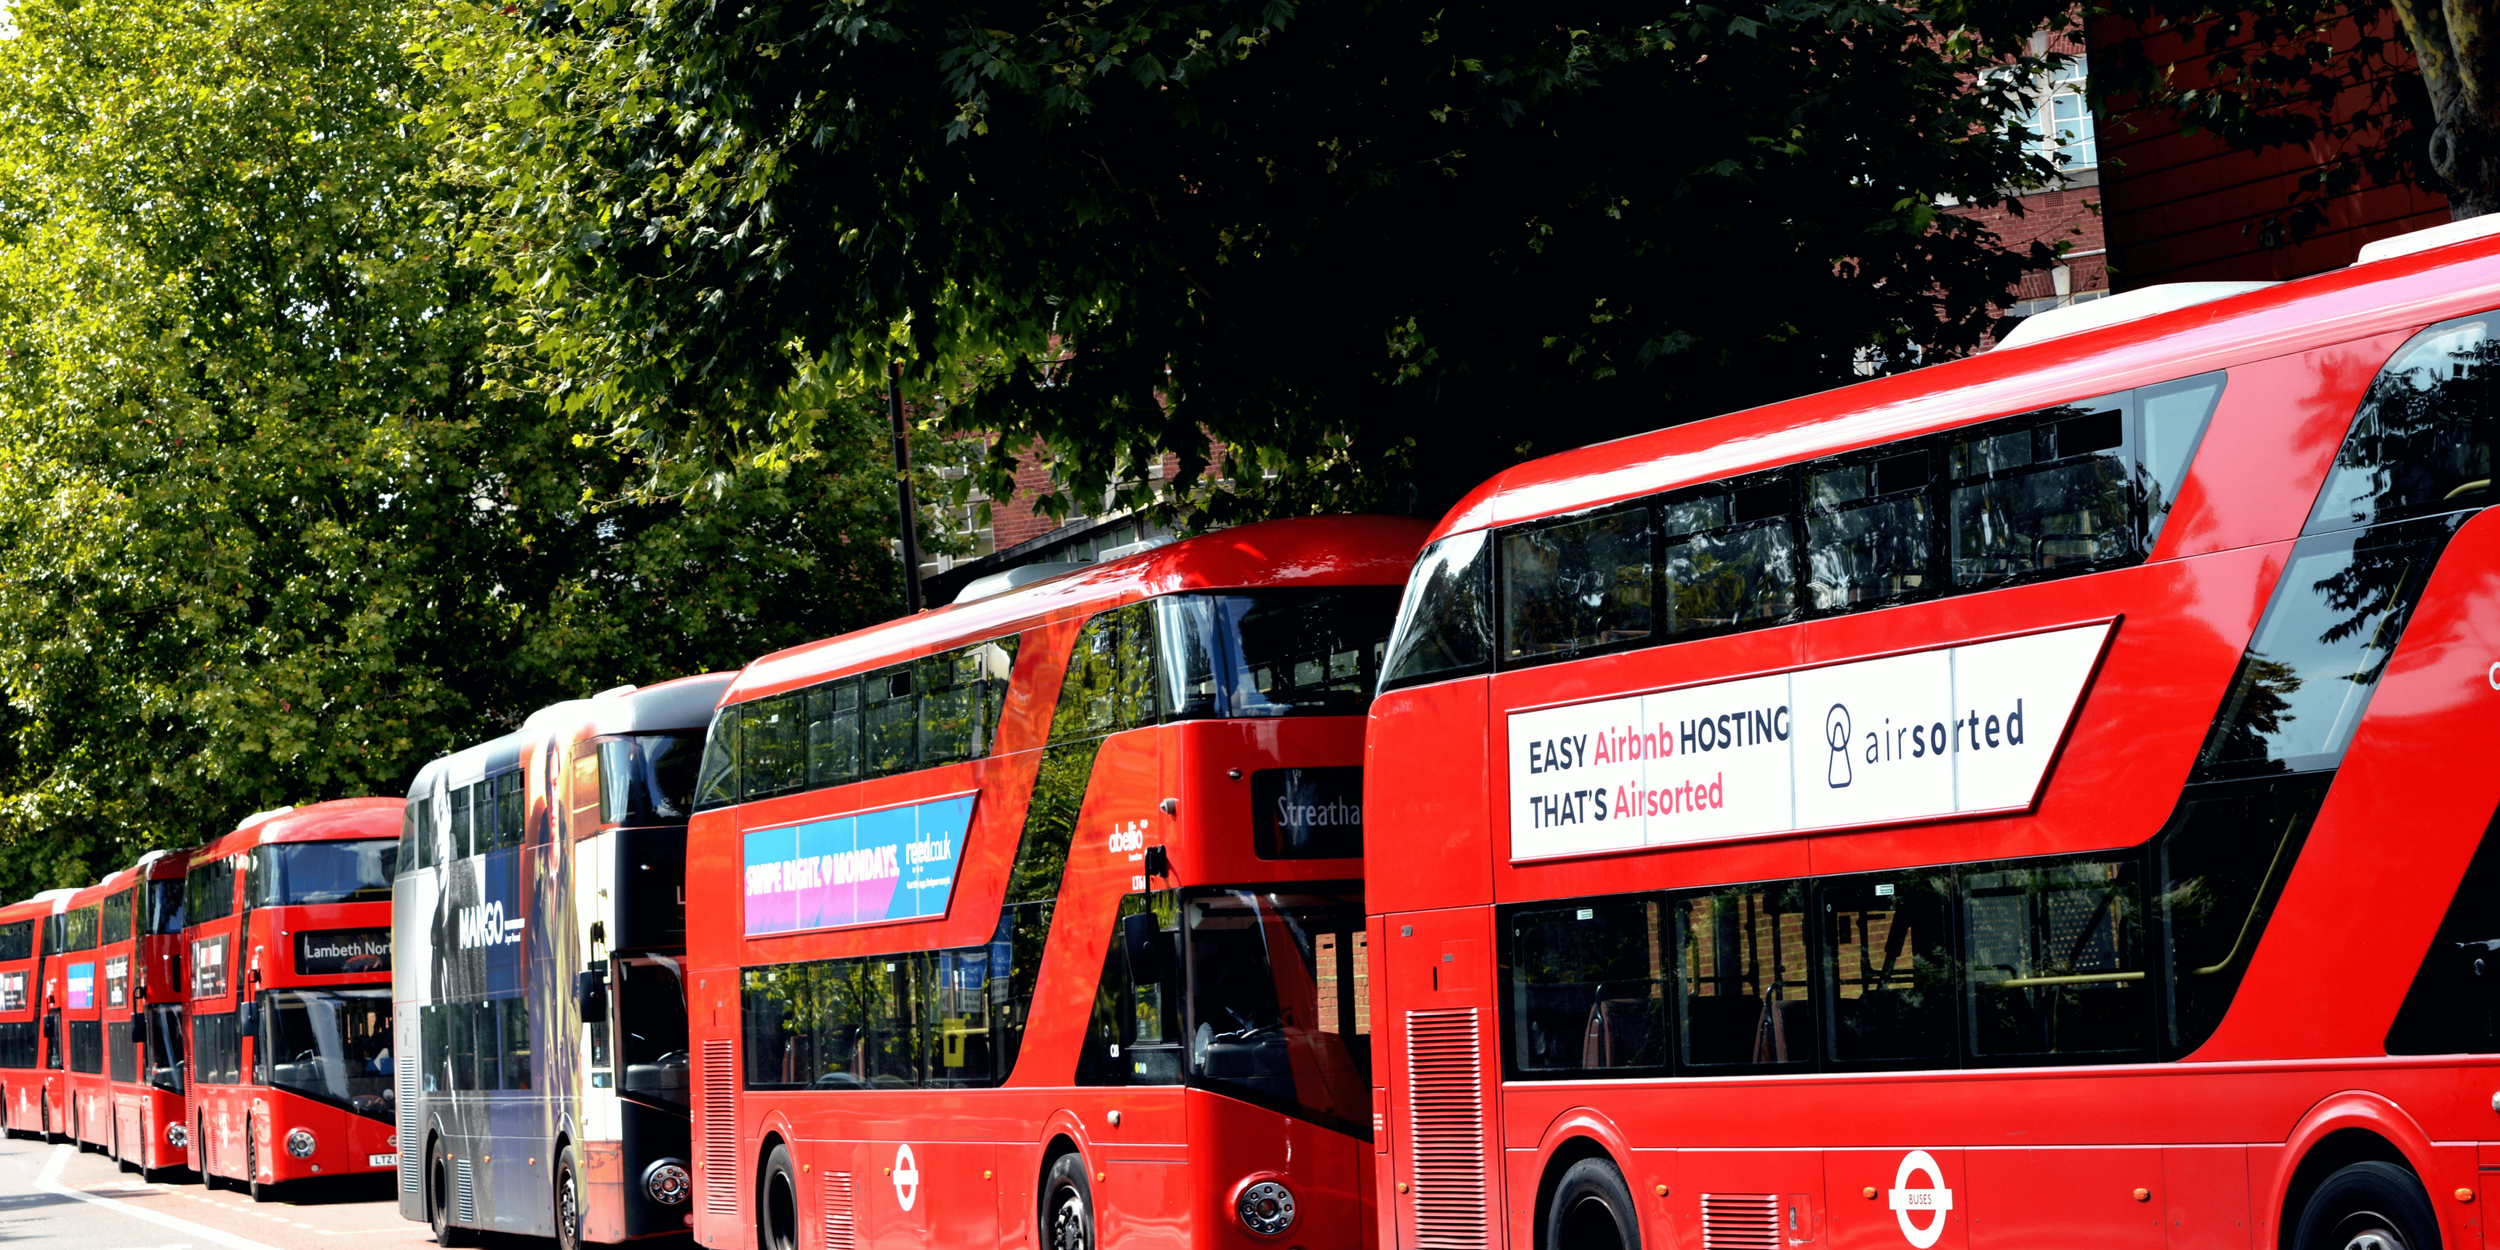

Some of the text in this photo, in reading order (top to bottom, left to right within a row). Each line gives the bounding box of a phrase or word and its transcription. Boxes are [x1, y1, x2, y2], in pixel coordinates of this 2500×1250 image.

[1530, 705, 1790, 774] EASY Airbnb HOSTING
[1866, 698, 2024, 764] airsorted
[1530, 772, 1723, 829] THAT'S Airsorted
[1109, 821, 1143, 853] abellio
[746, 861, 782, 896] SWIPE
[833, 844, 900, 885] MONDAYS.
[459, 900, 503, 949] MANGO
[307, 942, 361, 958] Lambeth
[1909, 1194, 1932, 1205] BUSES
